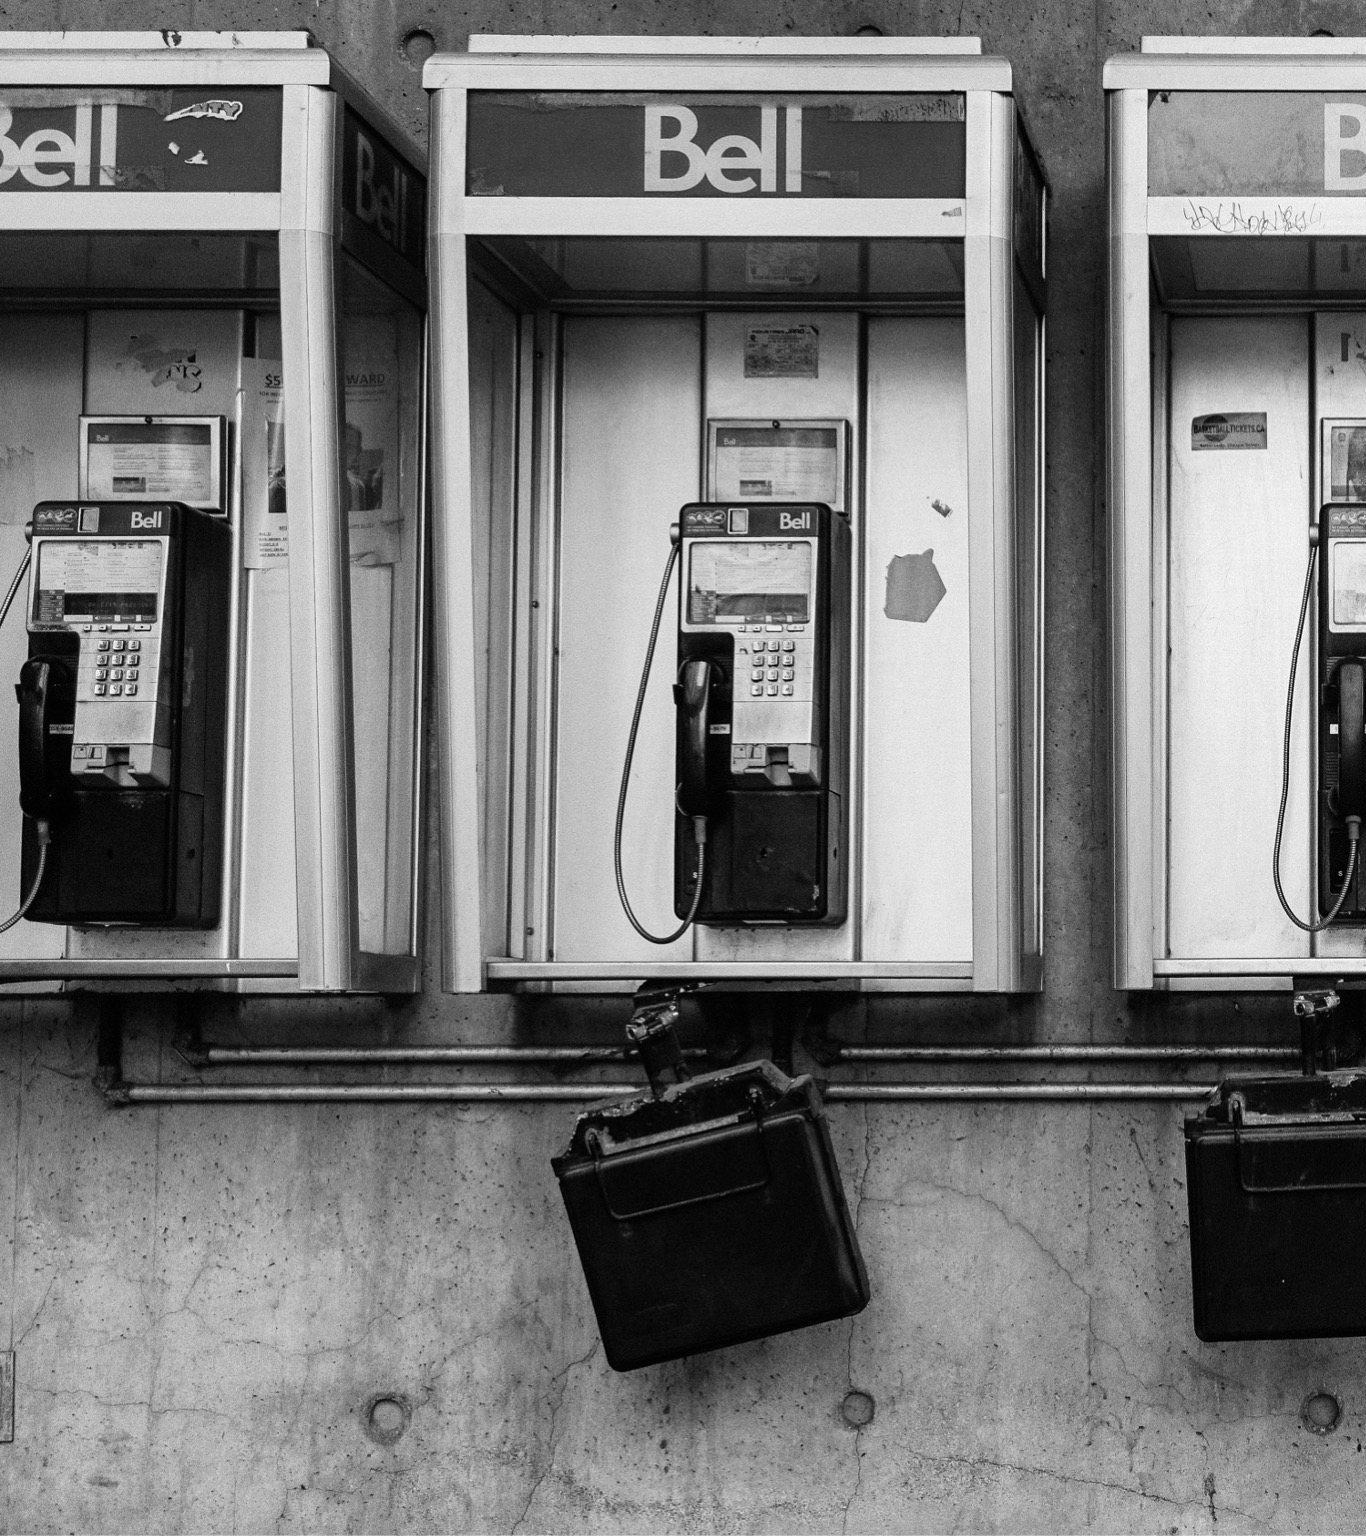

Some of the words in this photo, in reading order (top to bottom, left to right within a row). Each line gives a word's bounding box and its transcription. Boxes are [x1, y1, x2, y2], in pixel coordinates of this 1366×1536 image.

[643, 103, 801, 193] Bell
[357, 131, 408, 253] Bell
[265, 372, 283, 387] $5
[346, 373, 385, 386] WARD
[131, 511, 162, 529] Bell
[779, 512, 811, 530] Bell
